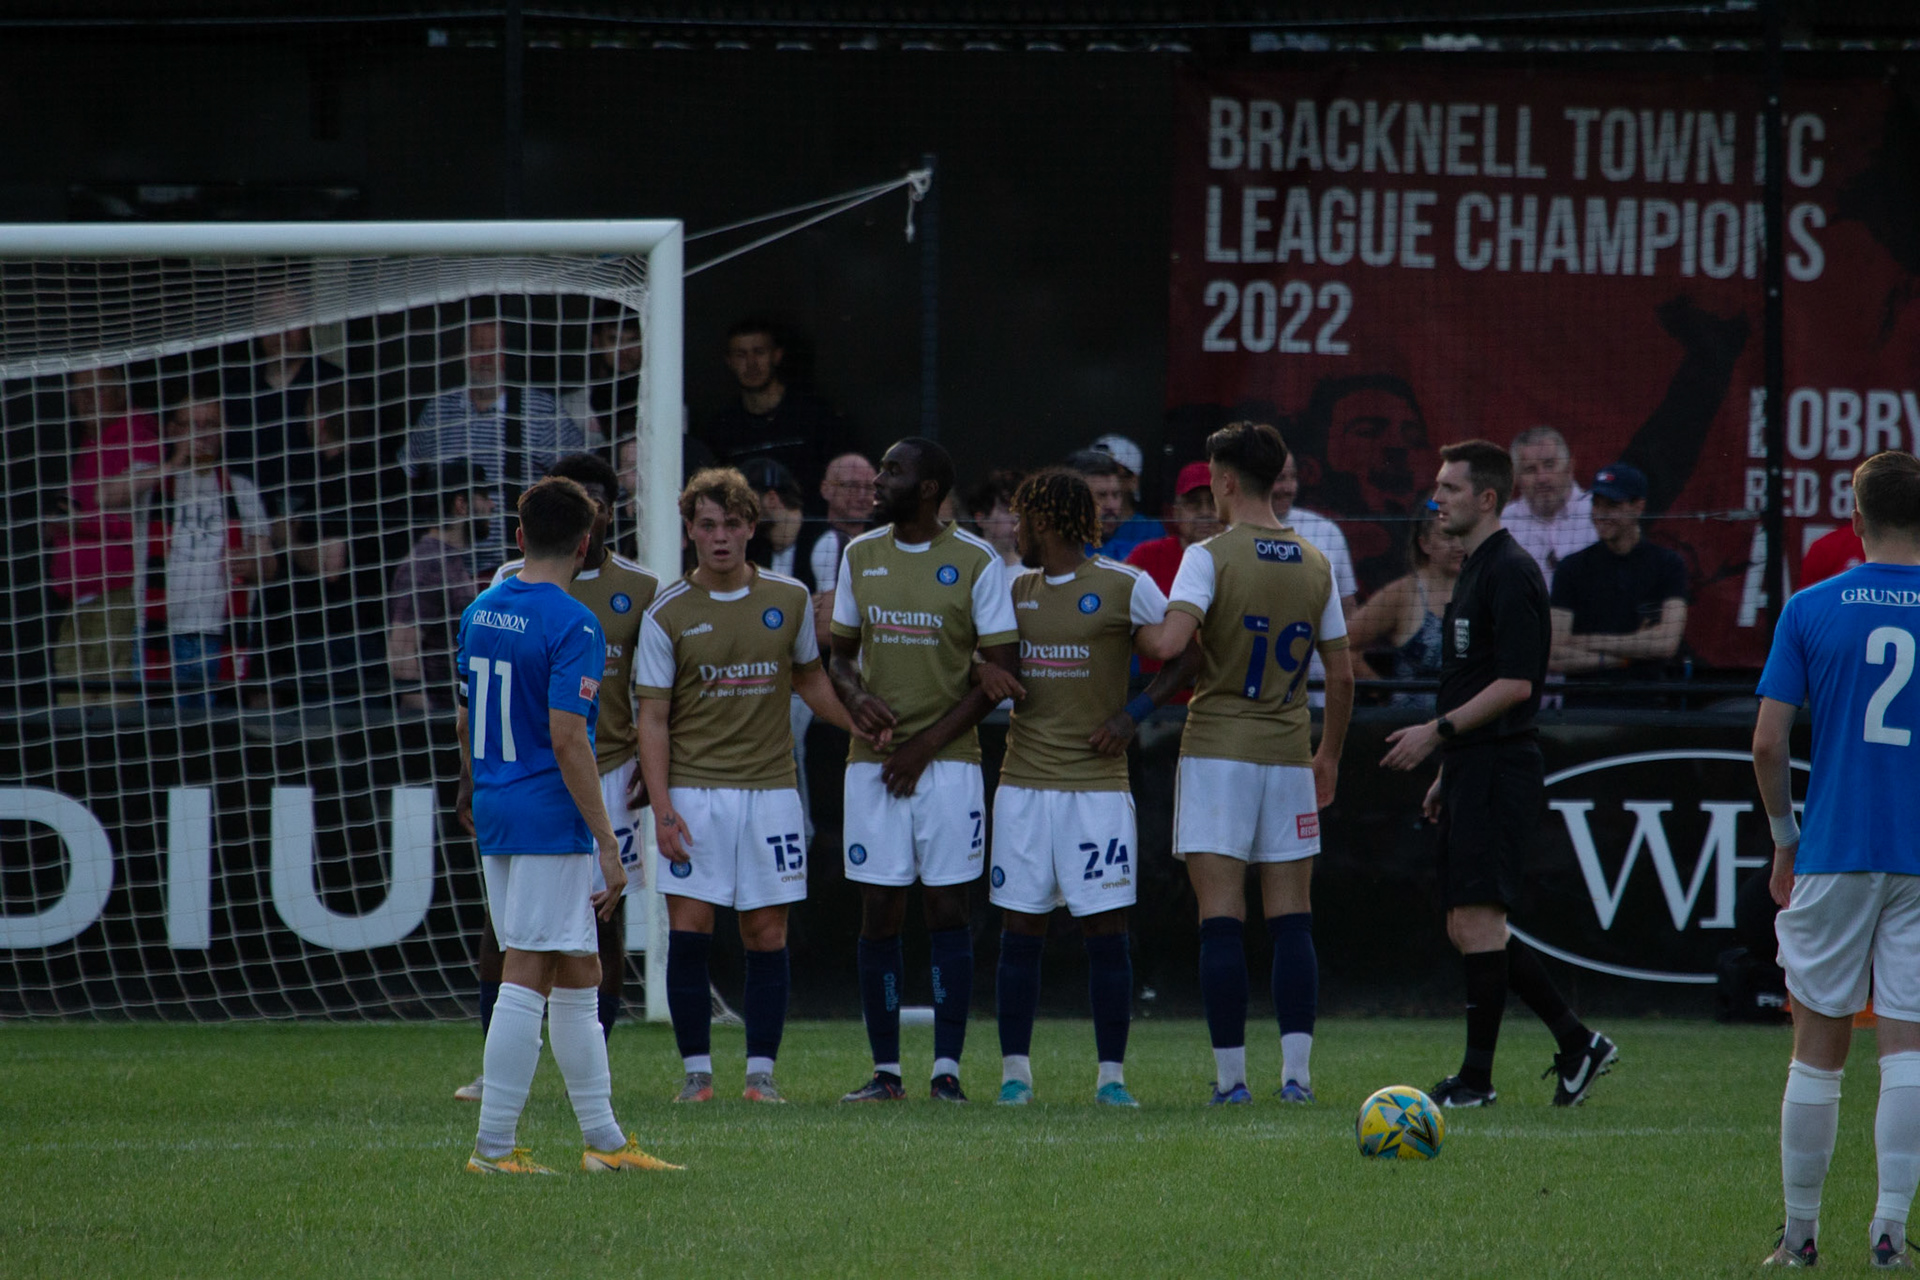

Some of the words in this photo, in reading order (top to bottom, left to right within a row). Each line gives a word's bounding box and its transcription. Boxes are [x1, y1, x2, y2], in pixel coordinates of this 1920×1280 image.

[1208, 96, 1548, 179] BRACKNELL
[1563, 106, 1737, 185] TOWN
[1203, 185, 1438, 269] LEAGUE
[1453, 191, 1827, 282] CHAMPIONS
[1201, 279, 1353, 356] 2022
[1256, 540, 1302, 560] origin
[1841, 588, 1920, 605] GRUND
[472, 609, 530, 632] GRUNDON
[867, 605, 944, 629] Dreams
[1020, 640, 1091, 659] Dreams
[1244, 615, 1314, 704] 19
[699, 661, 779, 681] Dreams
[1863, 626, 1916, 747] 2
[469, 656, 517, 762] 11
[766, 834, 804, 872] 15
[1079, 838, 1128, 881] 24
